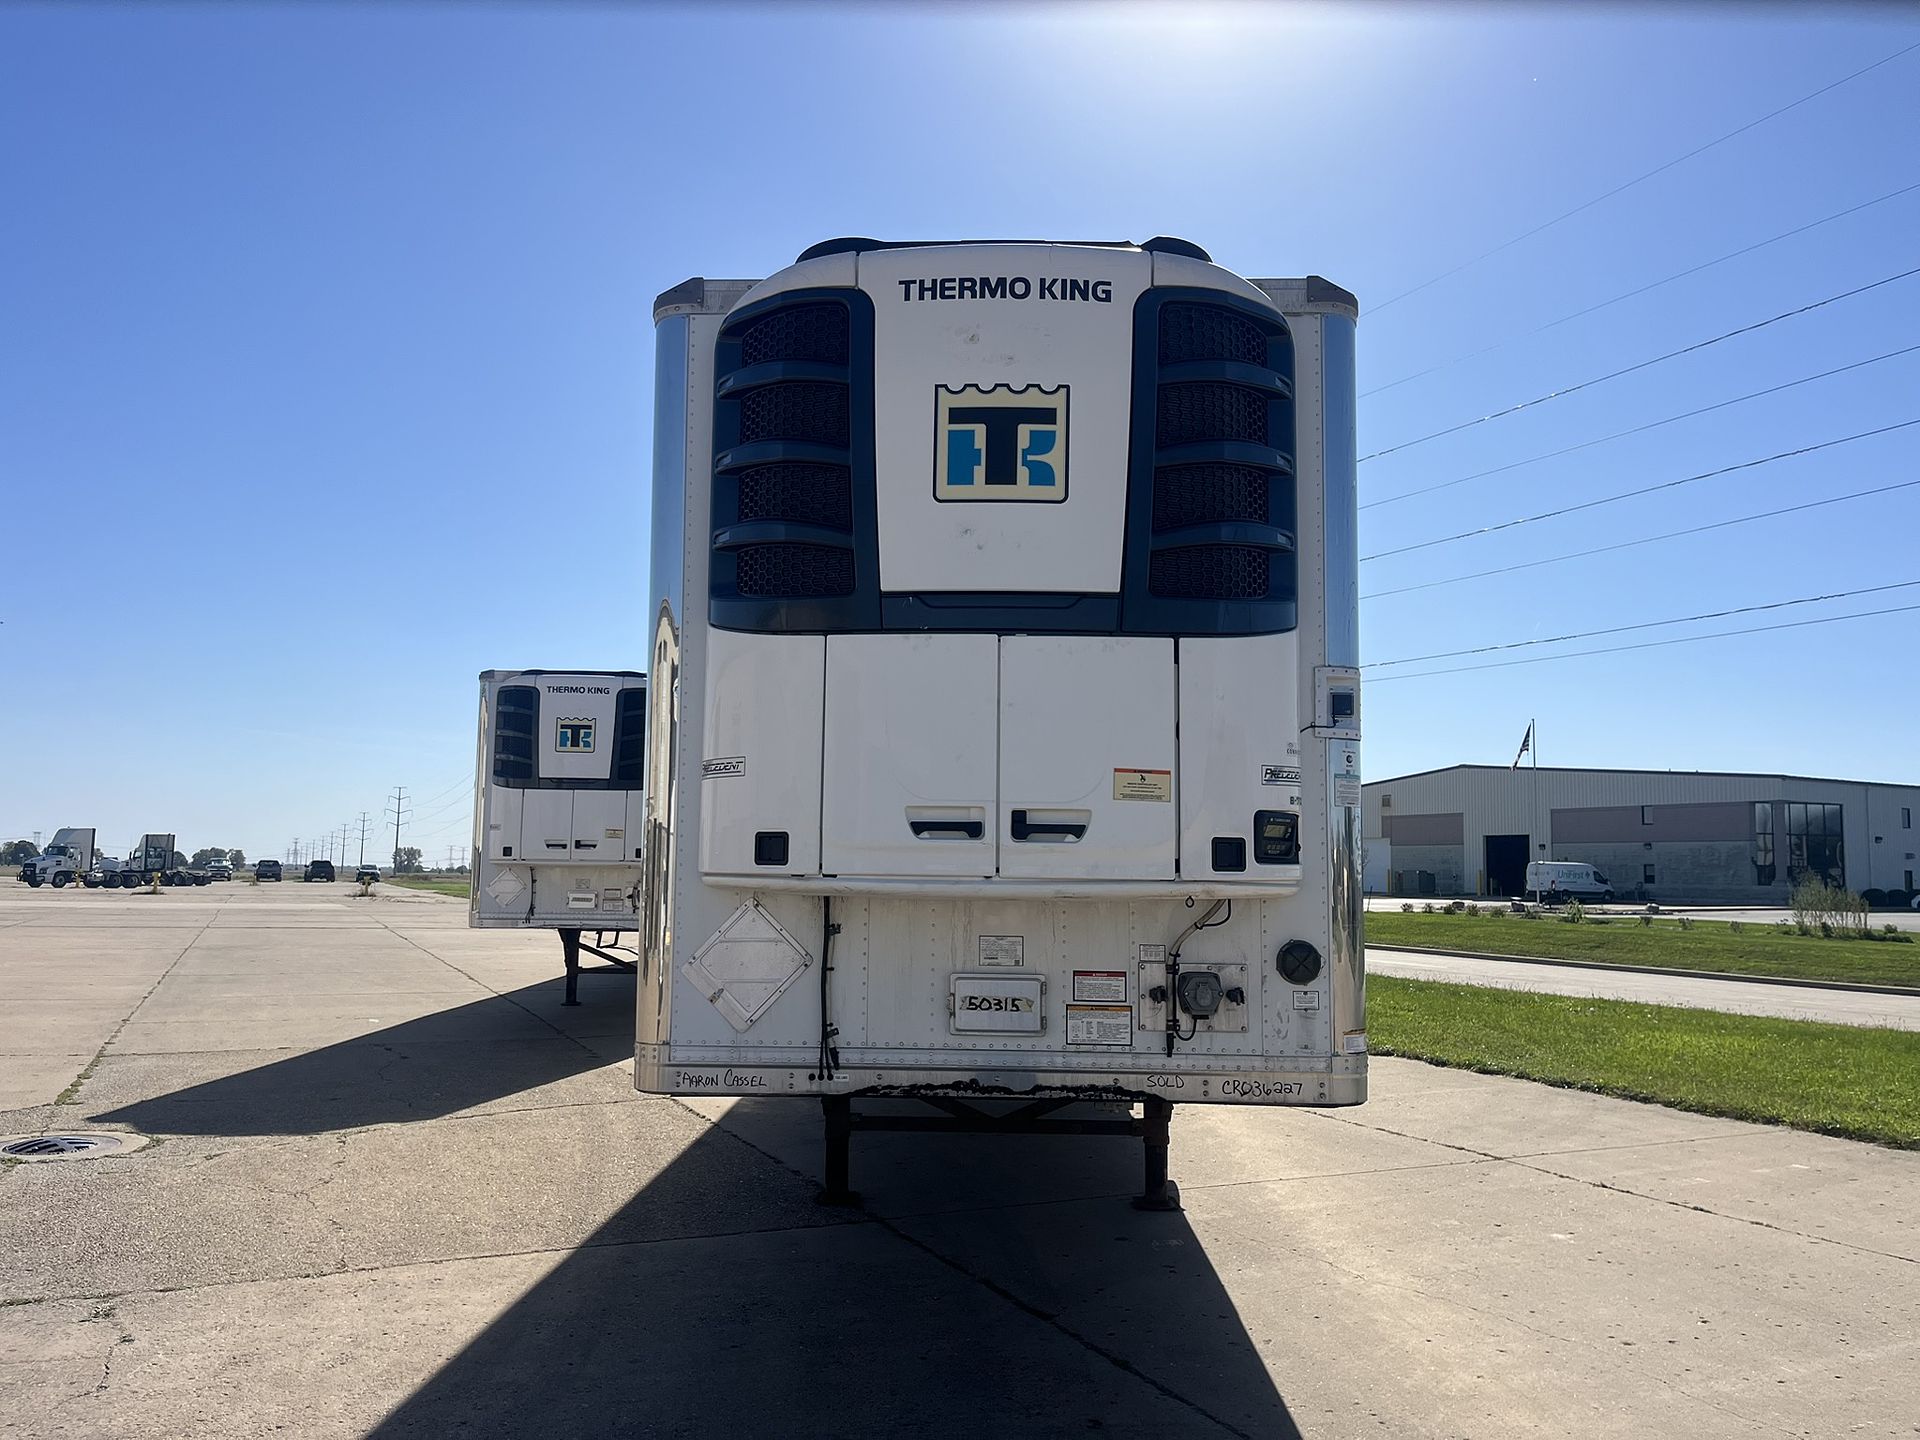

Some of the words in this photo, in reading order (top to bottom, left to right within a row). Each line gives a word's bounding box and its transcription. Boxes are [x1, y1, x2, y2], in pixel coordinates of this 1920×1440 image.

[898, 276, 1032, 302] THERMO
[1039, 277, 1113, 303] KING
[547, 685, 586, 694] THERMO
[587, 686, 610, 695] KING
[966, 995, 1023, 1012] 50315
[682, 1071, 719, 1088] AARON
[1146, 1074, 1186, 1090] SOLD
